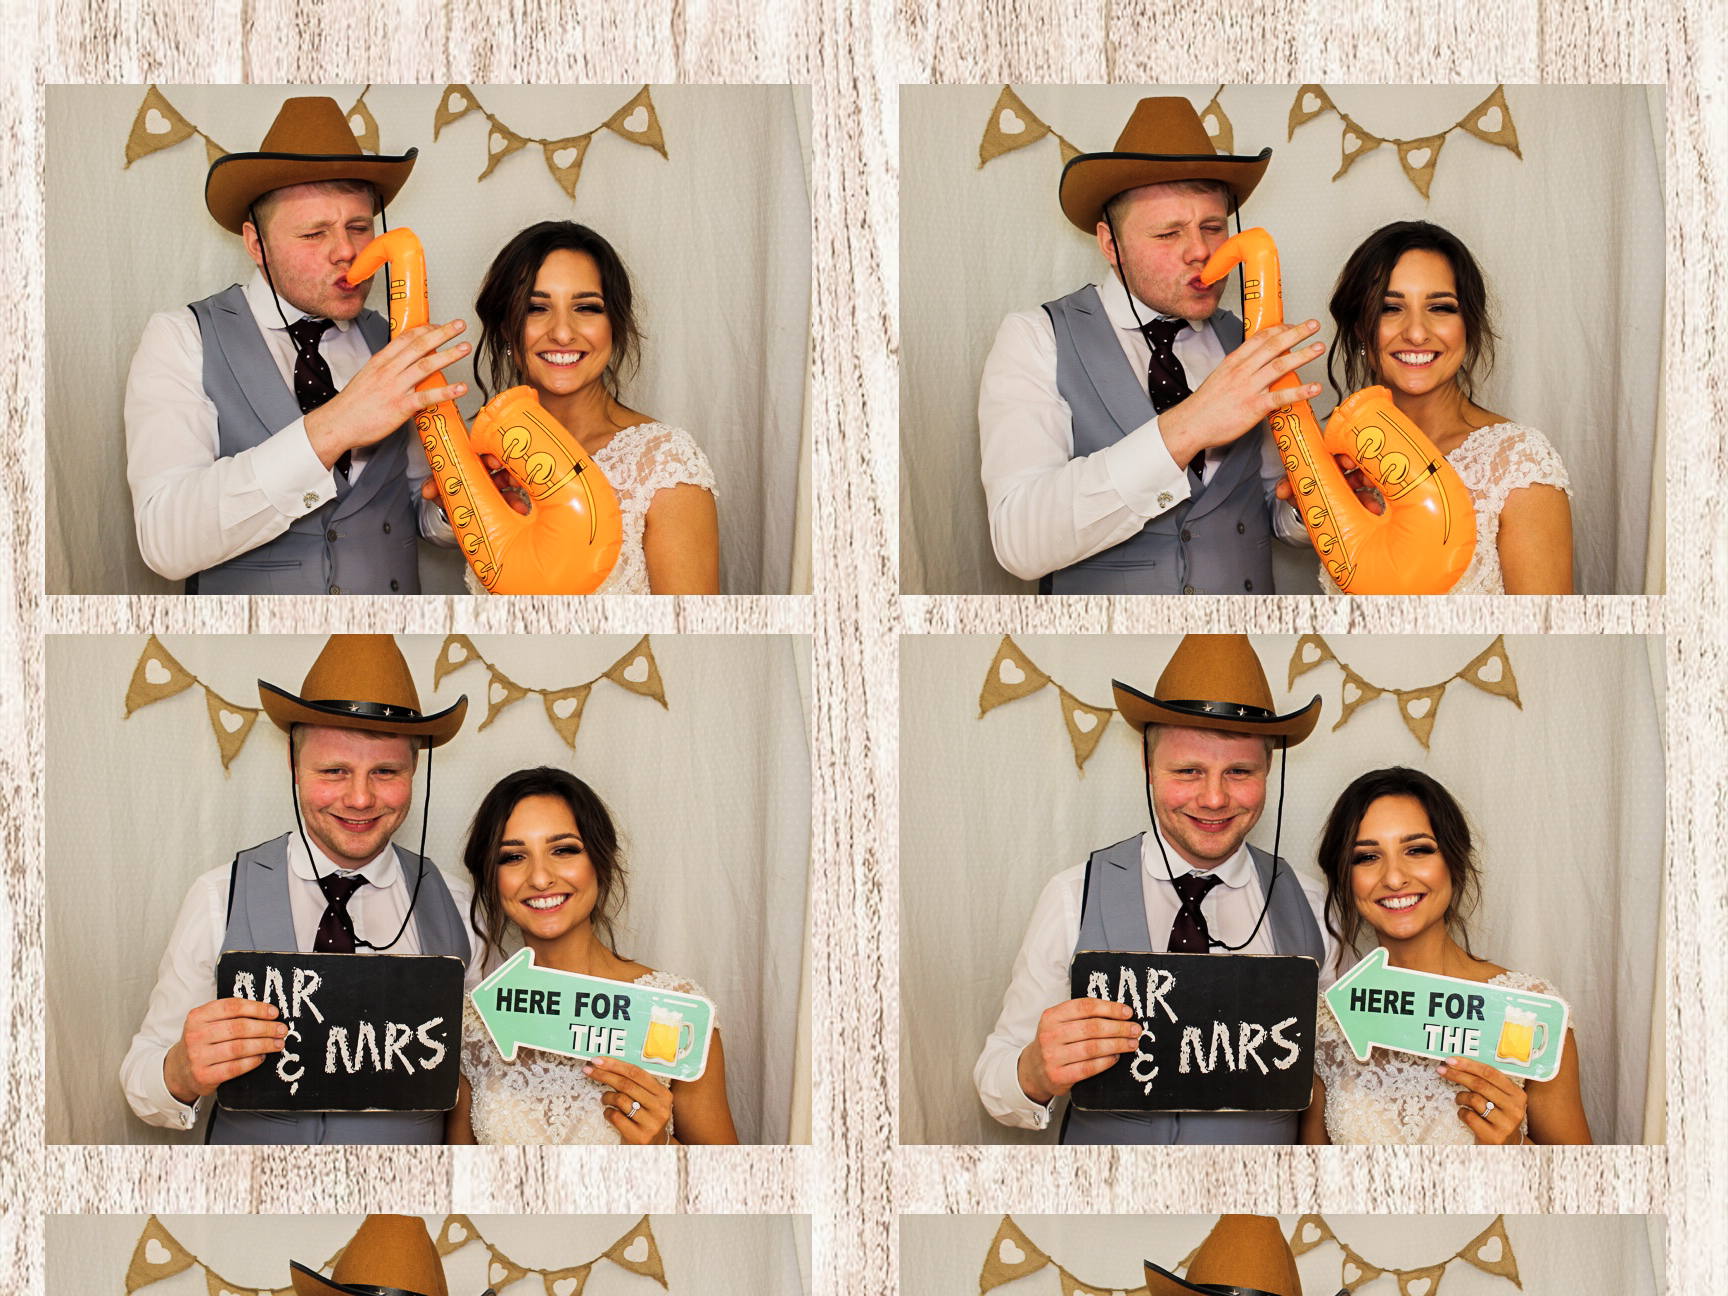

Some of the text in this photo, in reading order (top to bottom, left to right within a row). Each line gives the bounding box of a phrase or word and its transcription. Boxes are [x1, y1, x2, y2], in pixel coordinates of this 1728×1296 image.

[496, 987, 631, 1021] HERE FOR
[1350, 987, 1485, 1021] HERE FOR
[569, 1023, 628, 1057] THE
[1423, 1023, 1482, 1057] THE
